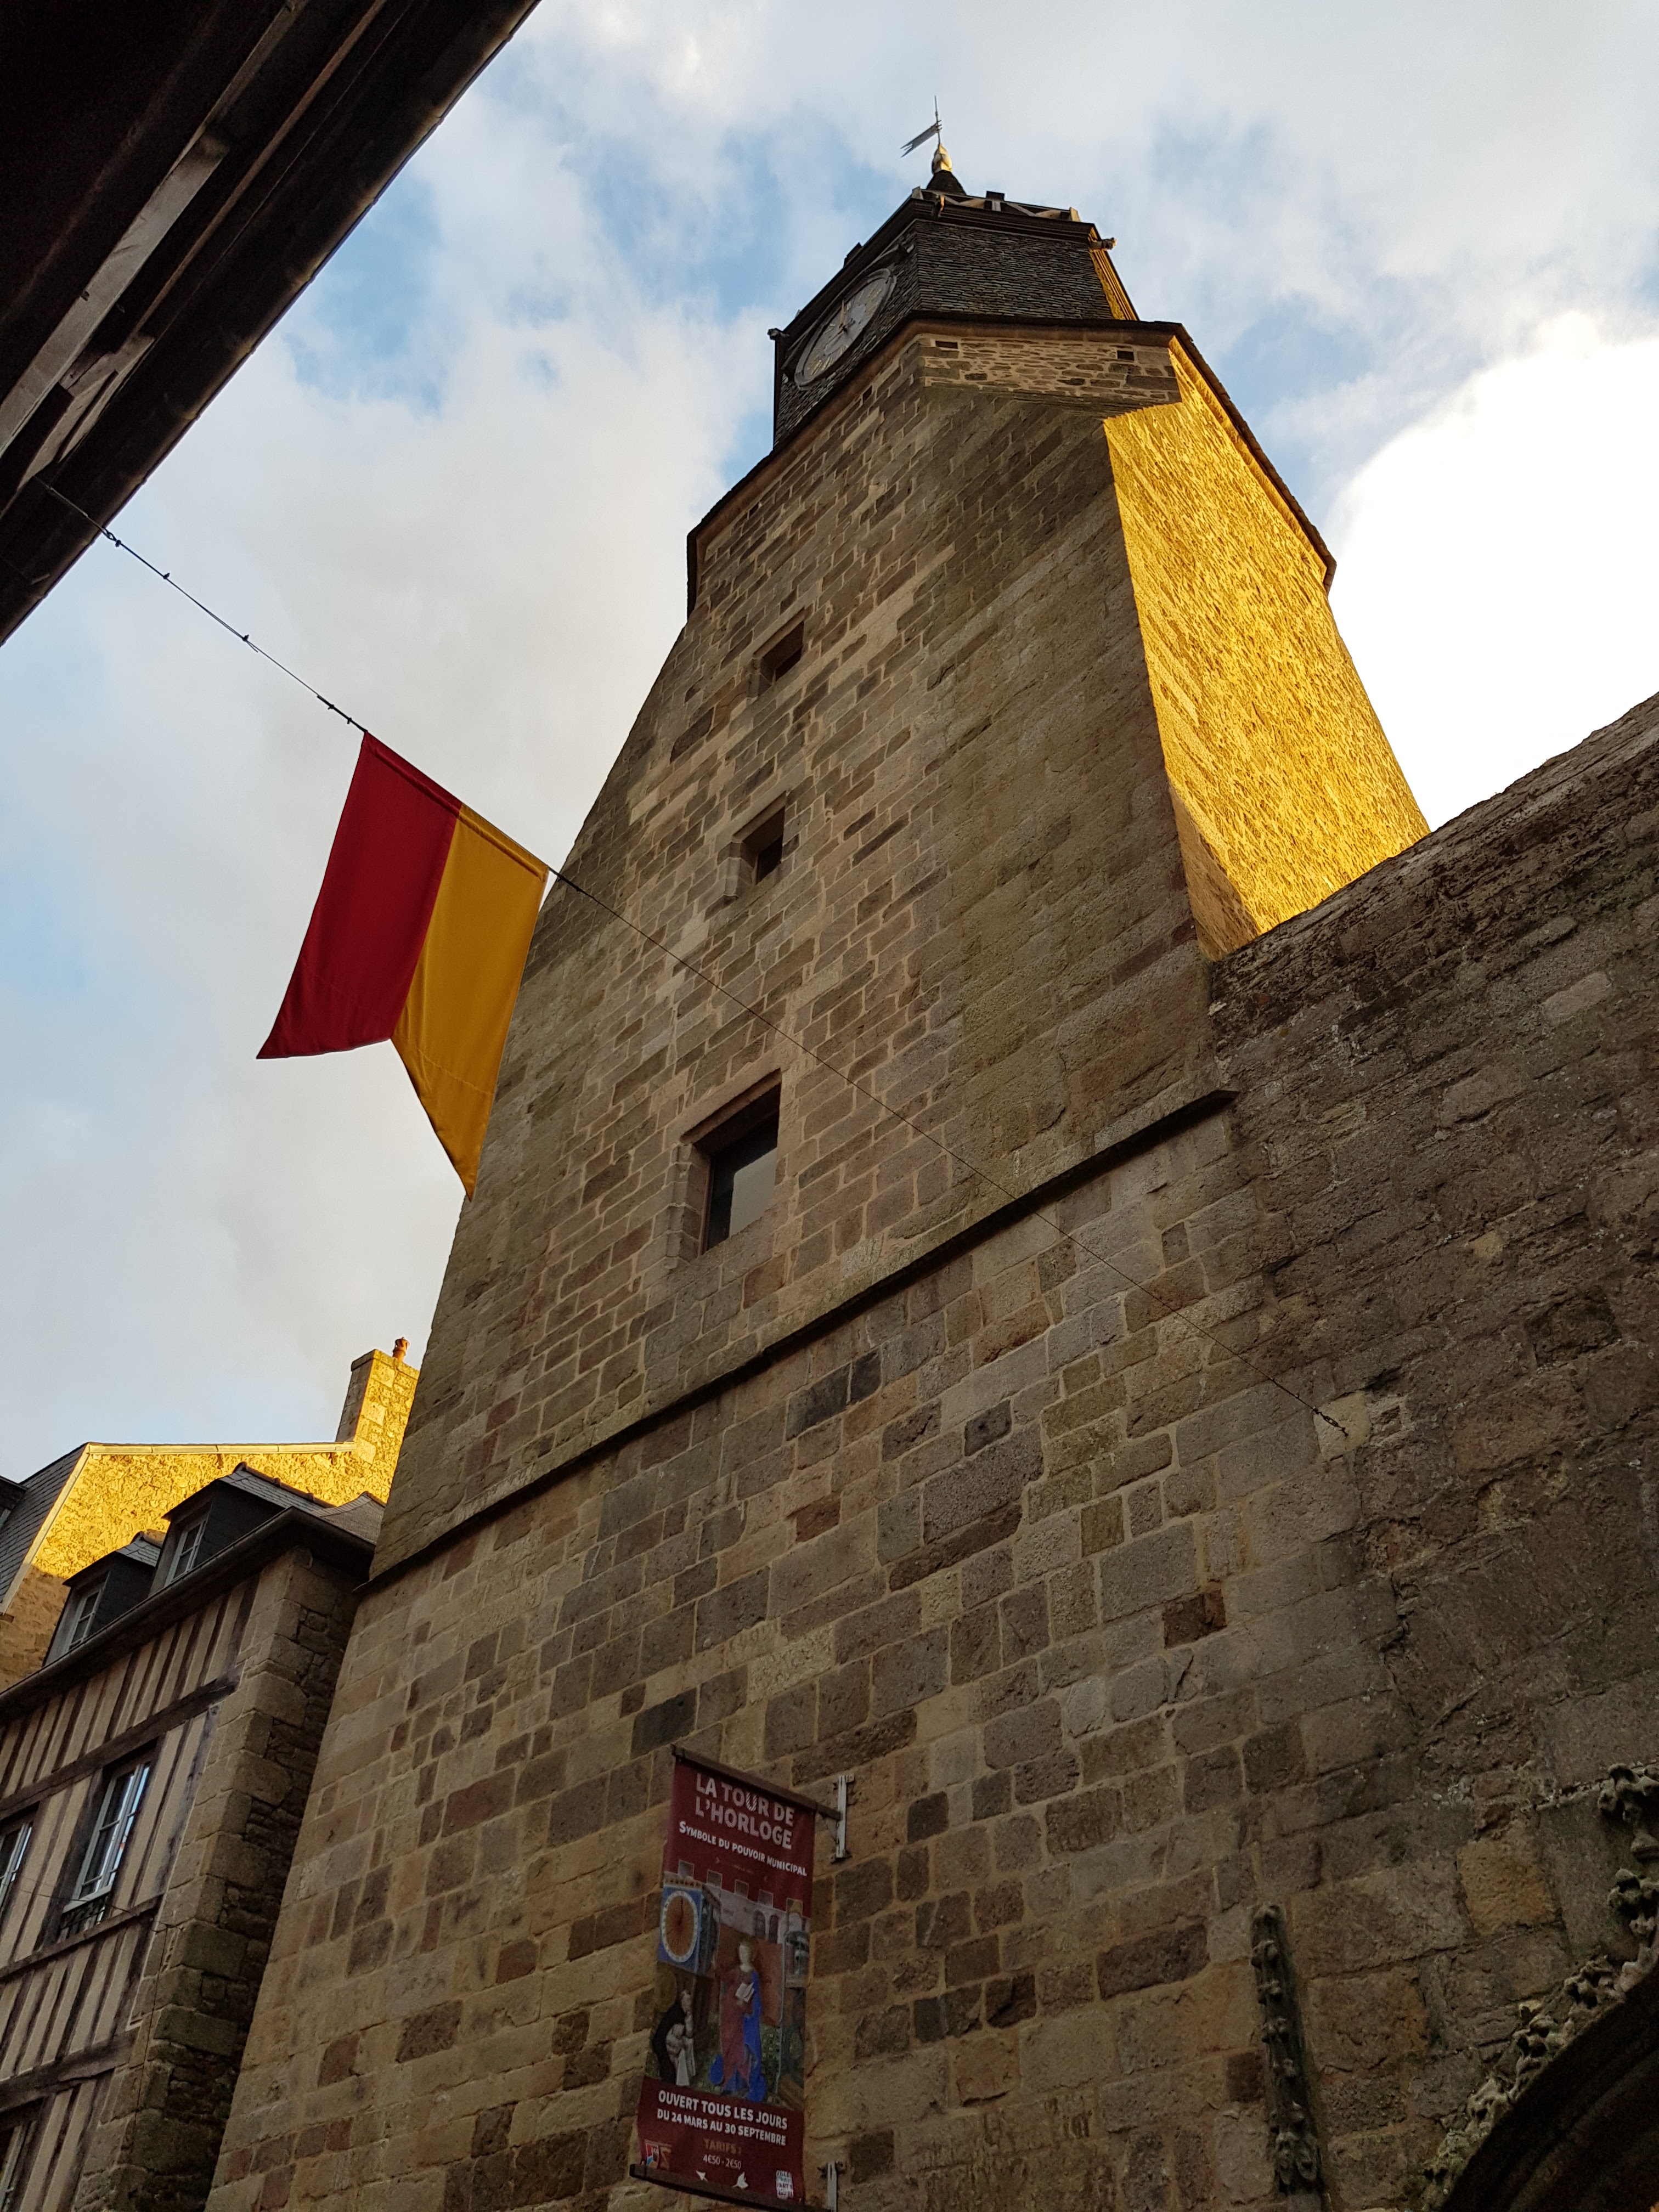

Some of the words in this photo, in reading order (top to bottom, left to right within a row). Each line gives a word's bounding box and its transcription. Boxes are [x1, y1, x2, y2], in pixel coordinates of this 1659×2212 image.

[695, 1796, 792, 1850] L'HORLOGE
[696, 1773, 717, 1798] LA
[721, 1781, 769, 1817] TOUR
[774, 1802, 795, 1827] DE
[679, 1820, 716, 1845] SYMBOLE
[718, 1838, 730, 1850] DU
[732, 1842, 765, 1863] POUVOIR
[768, 1855, 808, 1877] MUNICIPAL
[657, 2108, 670, 2121] DU
[672, 2112, 682, 2124] 24
[684, 2114, 708, 2130] MARS
[709, 2120, 723, 2132] AU
[725, 2123, 736, 2135] 30
[738, 2125, 786, 2147] SEPTEMBRE
[658, 2090, 699, 2111] OUVERT
[701, 2100, 732, 2118] TOUS
[734, 2106, 754, 2122] LES
[755, 2111, 788, 2130] JOURS
[703, 2138, 737, 2154] TARIFS
